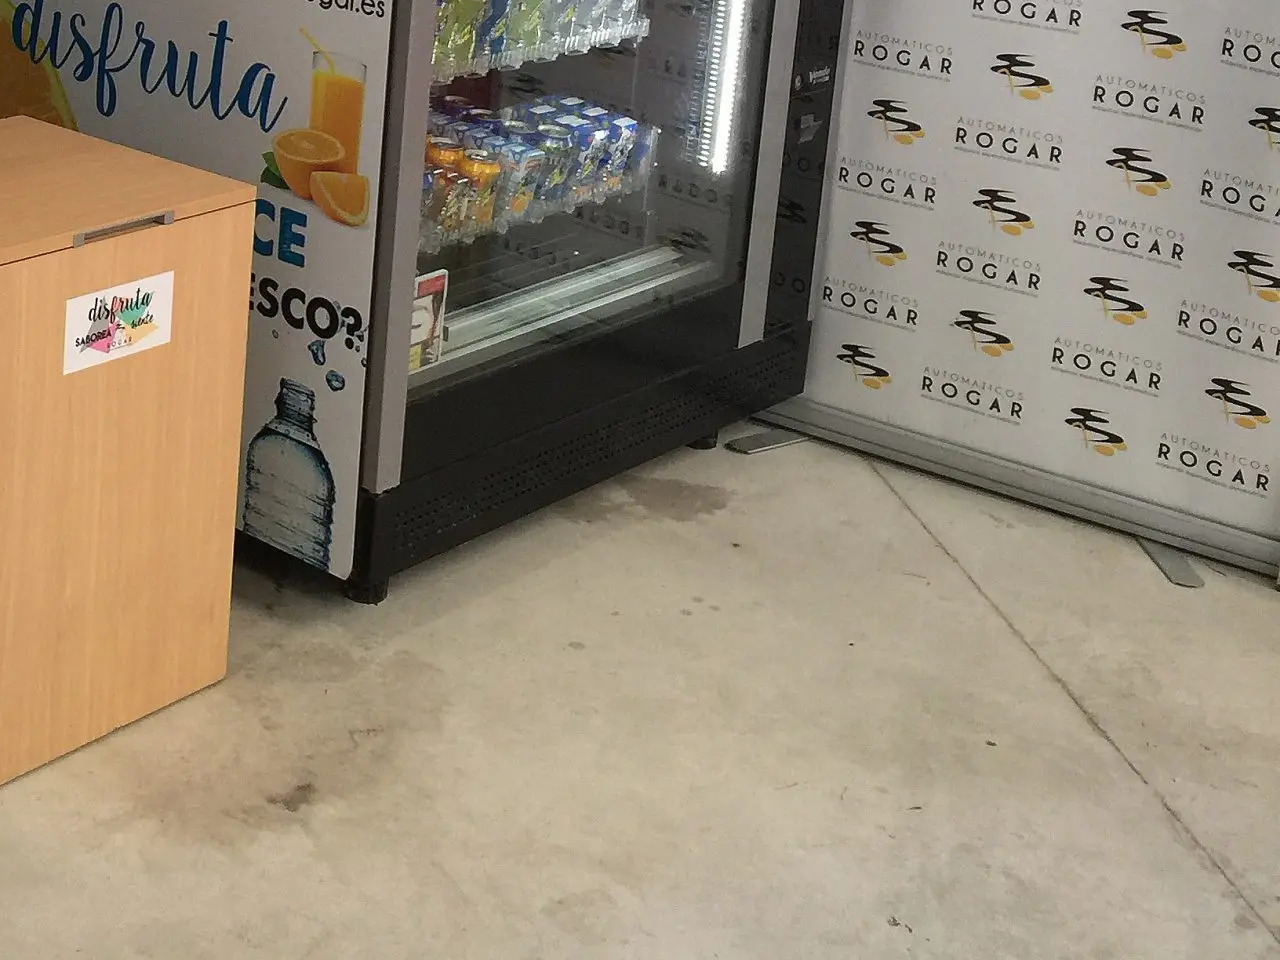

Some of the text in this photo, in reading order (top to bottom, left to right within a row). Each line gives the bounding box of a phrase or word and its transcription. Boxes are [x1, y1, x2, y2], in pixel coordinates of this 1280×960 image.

[853, 39, 953, 76] ROGAR
[856, 29, 954, 57] AUTOMATICOS
[1092, 84, 1205, 125] ROGAR
[1096, 73, 1207, 106] AUTOMATICOS
[955, 126, 1062, 164] ROGAR
[957, 115, 1064, 144] AUTOMATICOS
[88, 287, 155, 324] disfruta
[75, 328, 112, 347] SABOREA
[1054, 335, 1164, 371] AUTOMATICOS
[1051, 346, 1162, 391] ROGAR
[1157, 442, 1270, 492] ROGAR
[1160, 432, 1271, 473] AUTOMATICOS
